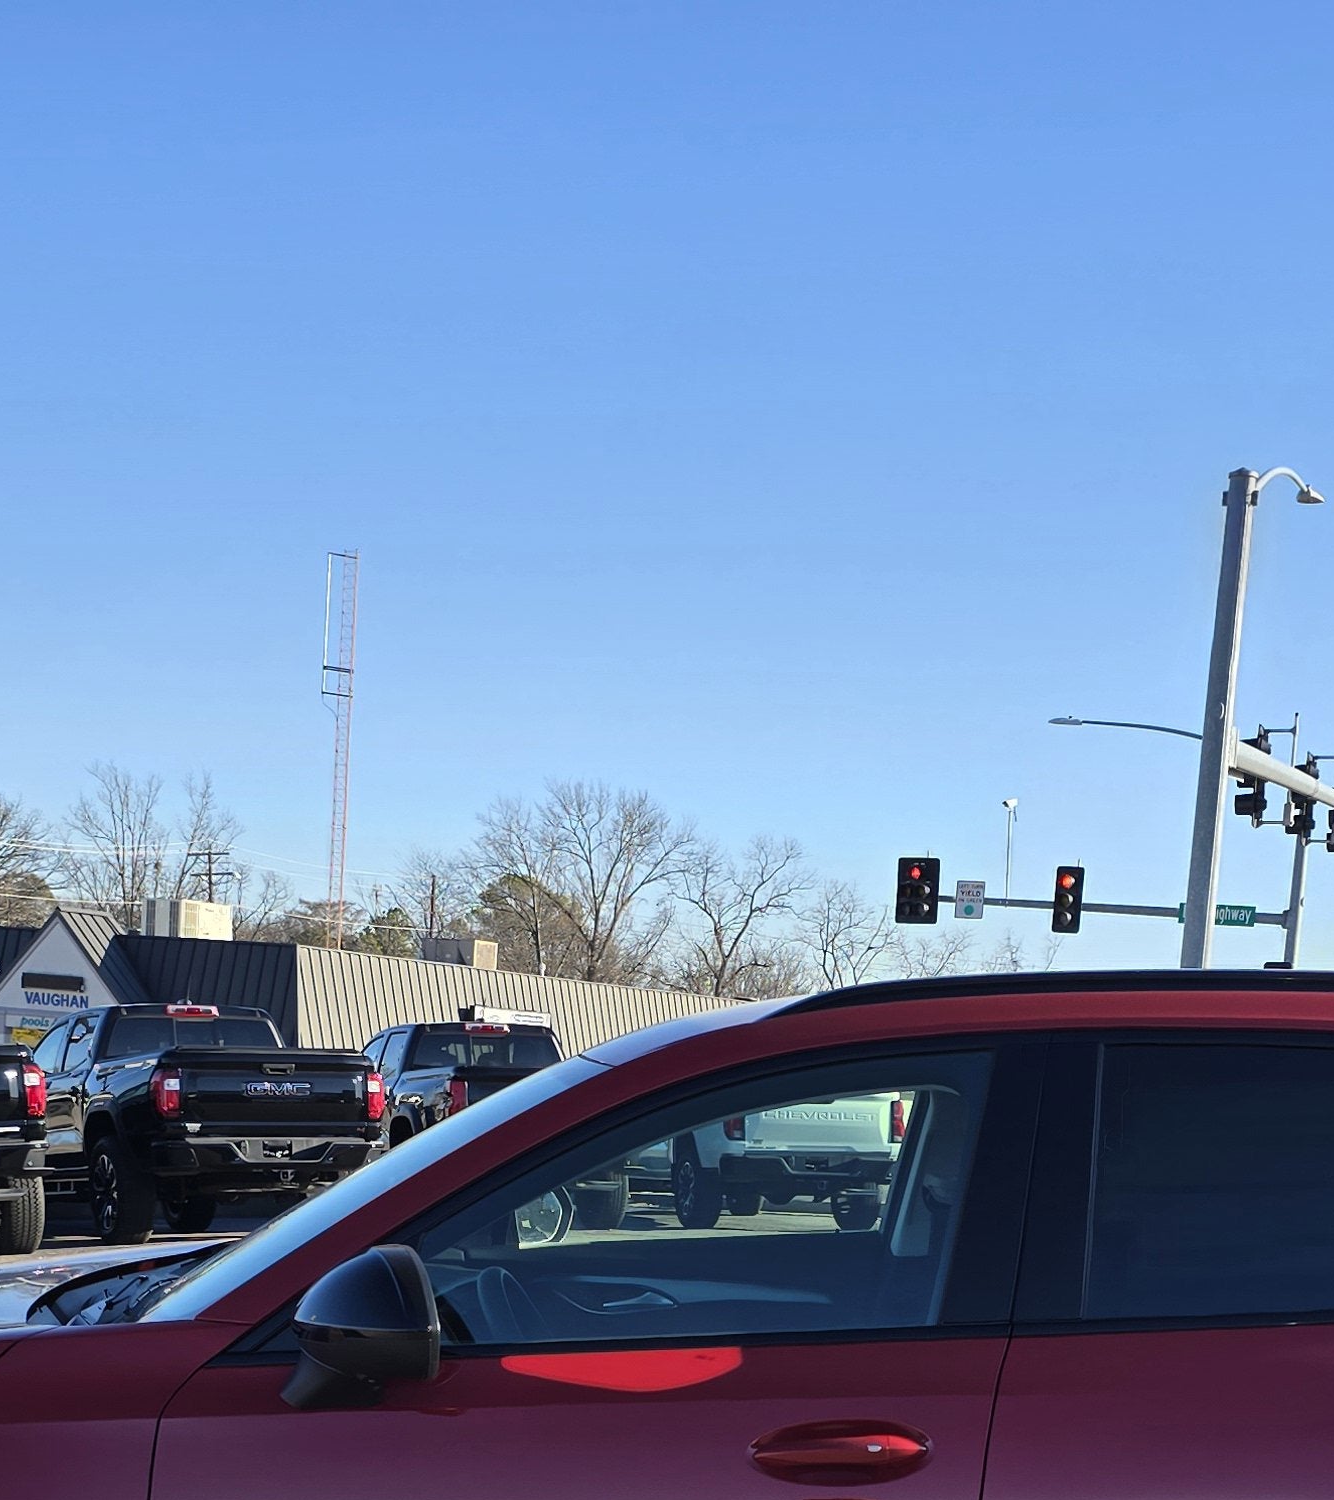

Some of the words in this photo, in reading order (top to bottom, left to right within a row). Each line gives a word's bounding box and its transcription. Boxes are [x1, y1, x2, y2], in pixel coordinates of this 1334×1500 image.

[1216, 905, 1253, 925] ighway
[24, 991, 89, 1009] VAUGHAN
[245, 1081, 311, 1097] GMC
[761, 1110, 877, 1121] CHEVROLET
